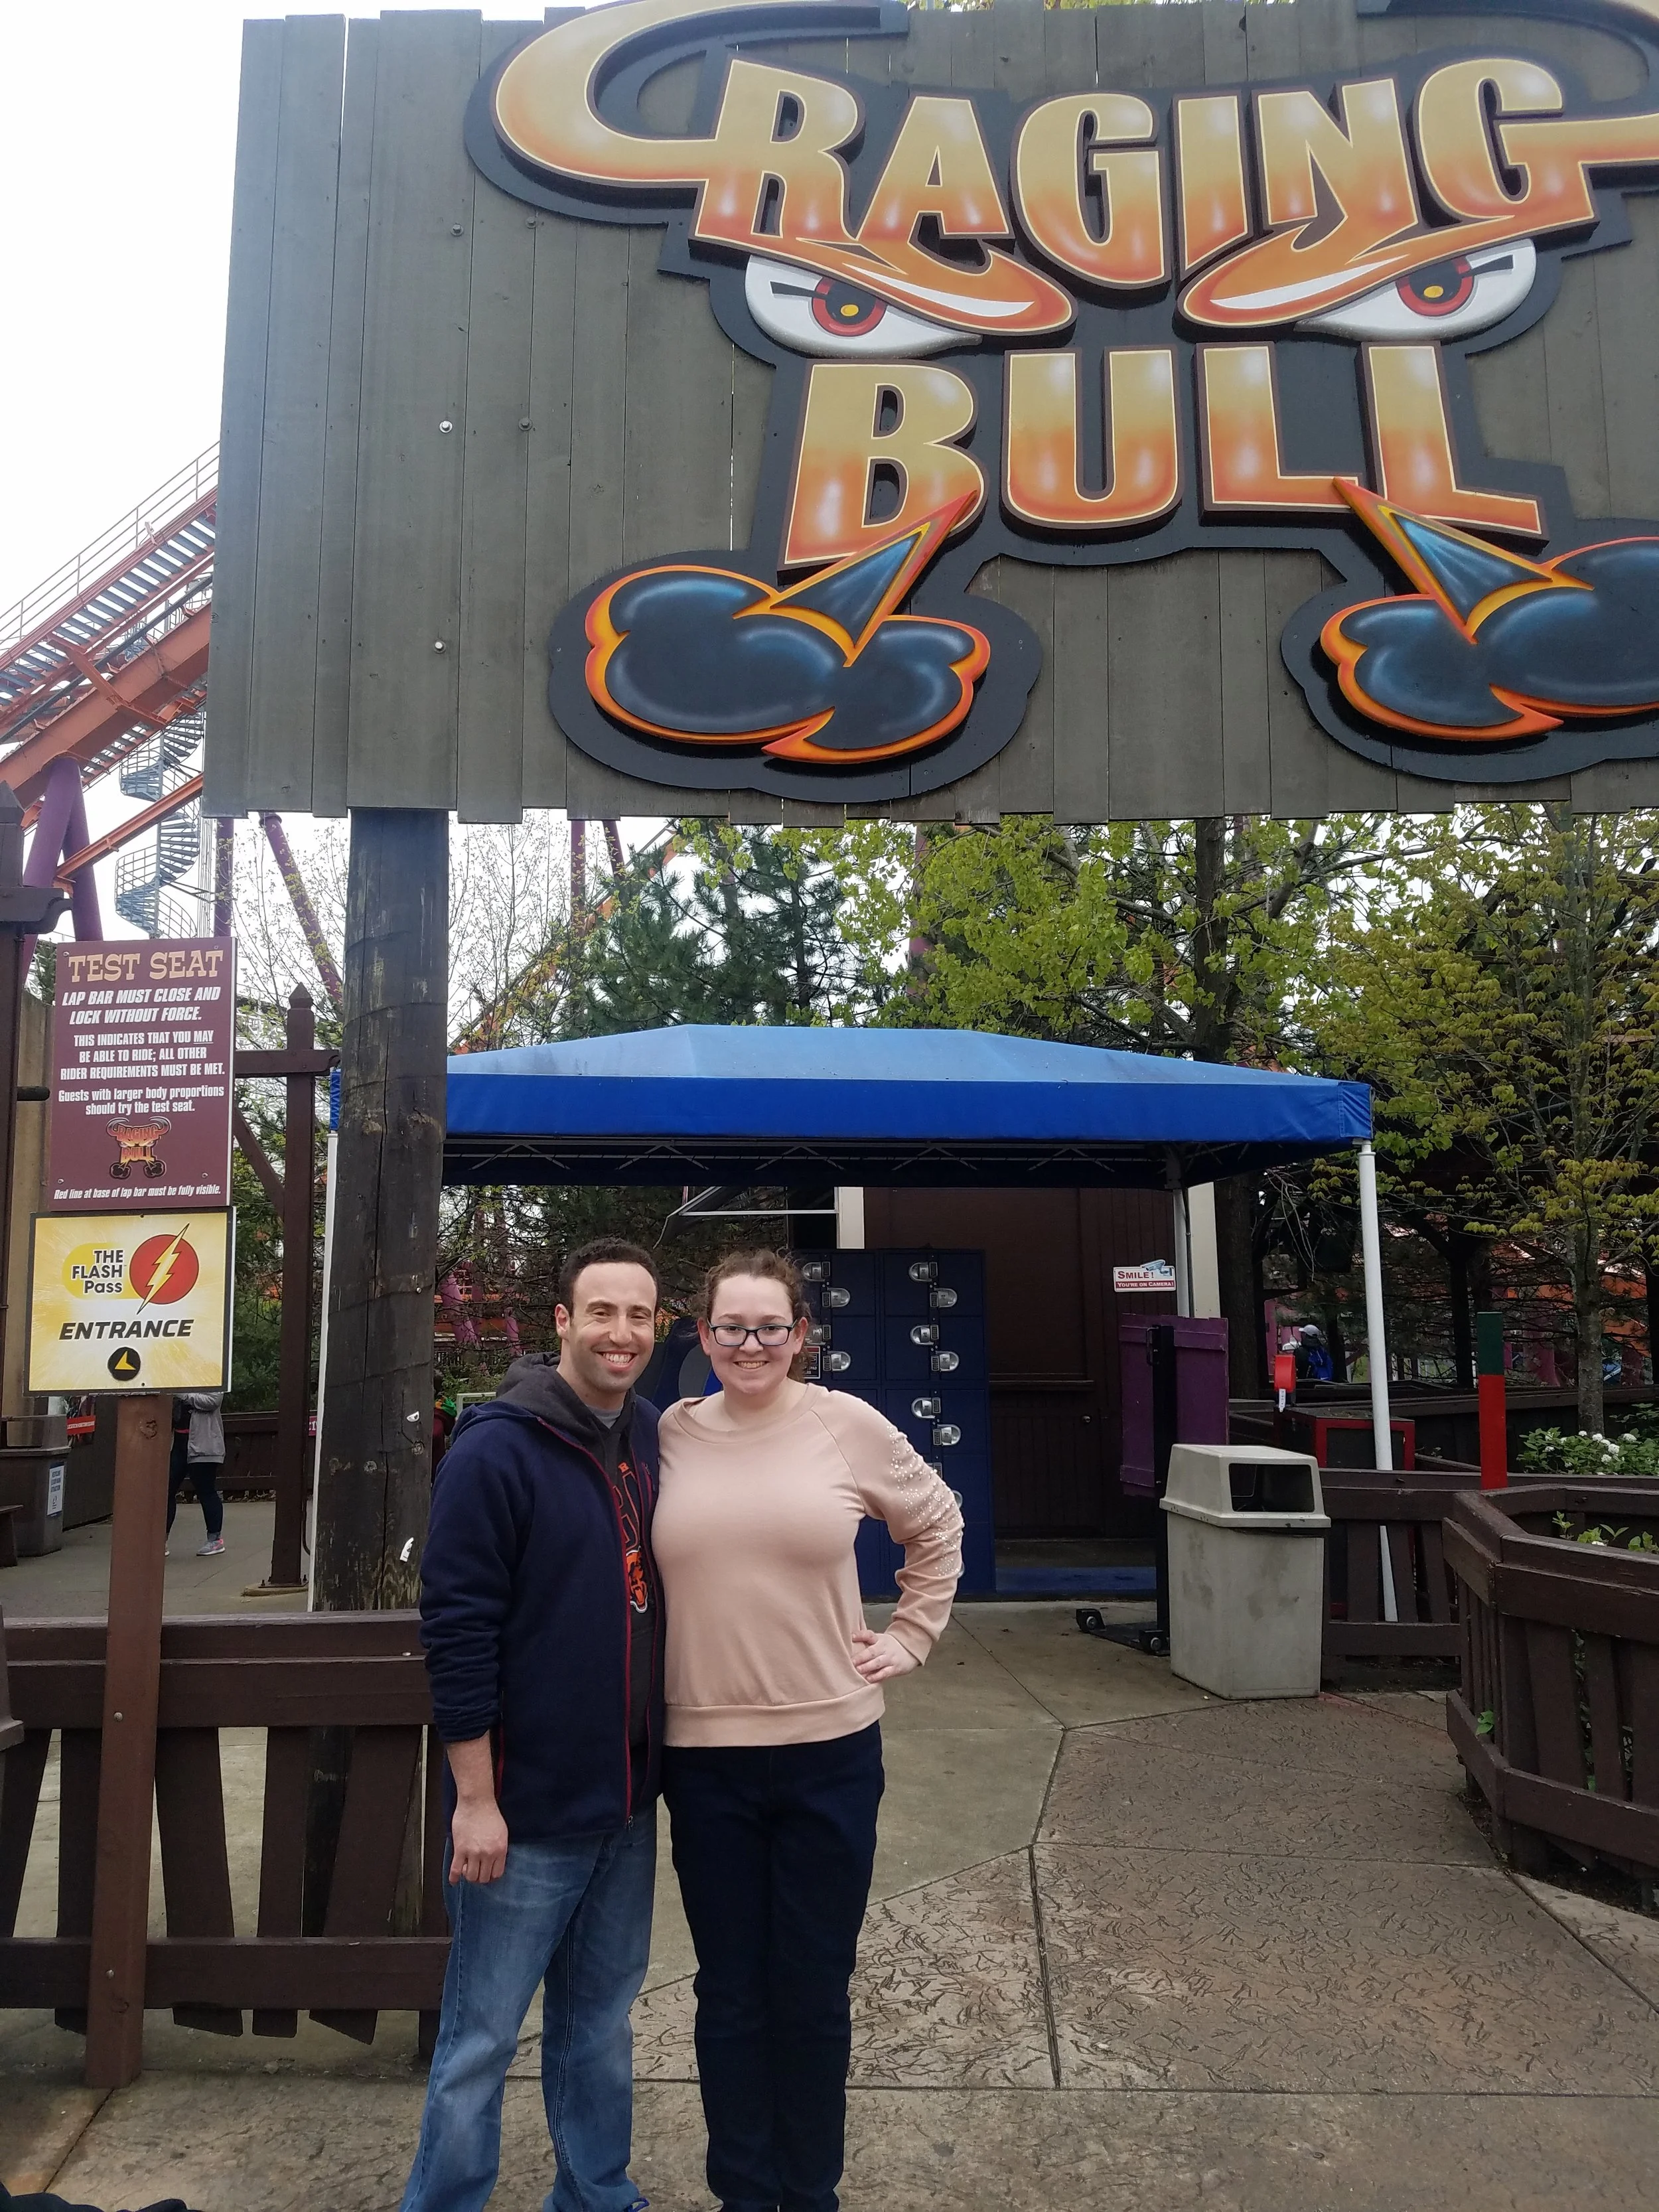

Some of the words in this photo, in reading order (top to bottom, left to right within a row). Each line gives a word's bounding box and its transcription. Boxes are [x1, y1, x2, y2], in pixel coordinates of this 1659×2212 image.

[692, 56, 1596, 292] RAGING
[780, 340, 1545, 569] BULL
[68, 953, 140, 982] TEST
[149, 950, 224, 980] SEAT
[62, 992, 85, 1006] LAP
[87, 990, 113, 1005] BAR
[115, 989, 153, 1003] MUST
[154, 988, 192, 1002] CLOSE
[194, 986, 221, 1001] AND
[69, 1009, 101, 1025] LOCK
[104, 1007, 159, 1023] WITHOUT
[161, 1006, 202, 1021] FORCE.
[74, 1035, 95, 1047] THIS
[98, 1033, 145, 1046] INDICATES
[147, 1032, 171, 1045] THAT
[172, 1031, 192, 1044] YOU
[193, 1030, 214, 1043] MAY
[79, 1051, 92, 1063] BE
[93, 1050, 115, 1063] ABLE
[117, 1049, 129, 1061] TO
[132, 1049, 157, 1062] RIDE;
[159, 1048, 175, 1060] ALL
[177, 1046, 207, 1059] OTHER
[60, 1068, 88, 1080] RIDER
[90, 1065, 159, 1080] REQUIREMENTS
[161, 1064, 187, 1076] MUST
[189, 1063, 202, 1075] BE
[204, 1062, 225, 1075] MET.
[58, 1089, 90, 1102] Guests
[92, 1088, 111, 1101] with
[113, 1087, 143, 1102] larger
[145, 1086, 168, 1100] body
[169, 1085, 224, 1100] proportions
[86, 1103, 116, 1116] should
[117, 1102, 133, 1116] try
[134, 1102, 149, 1114] the
[151, 1101, 171, 1113] test
[173, 1100, 195, 1112] seat.
[54, 1189, 68, 1199] Red
[69, 1189, 83, 1199] line
[84, 1189, 92, 1199] at
[93, 1188, 110, 1199] base
[111, 1187, 119, 1198] of
[121, 1187, 133, 1199] lap
[133, 1187, 147, 1197] bar
[147, 1186, 166, 1197] must
[167, 1186, 177, 1196] be
[178, 1185, 194, 1197] fully
[196, 1184, 221, 1195] visible.
[94, 1249, 123, 1263] THE
[72, 1265, 123, 1279] FLASH
[84, 1280, 122, 1293] Pass
[59, 1319, 194, 1340] ENTRANCE
